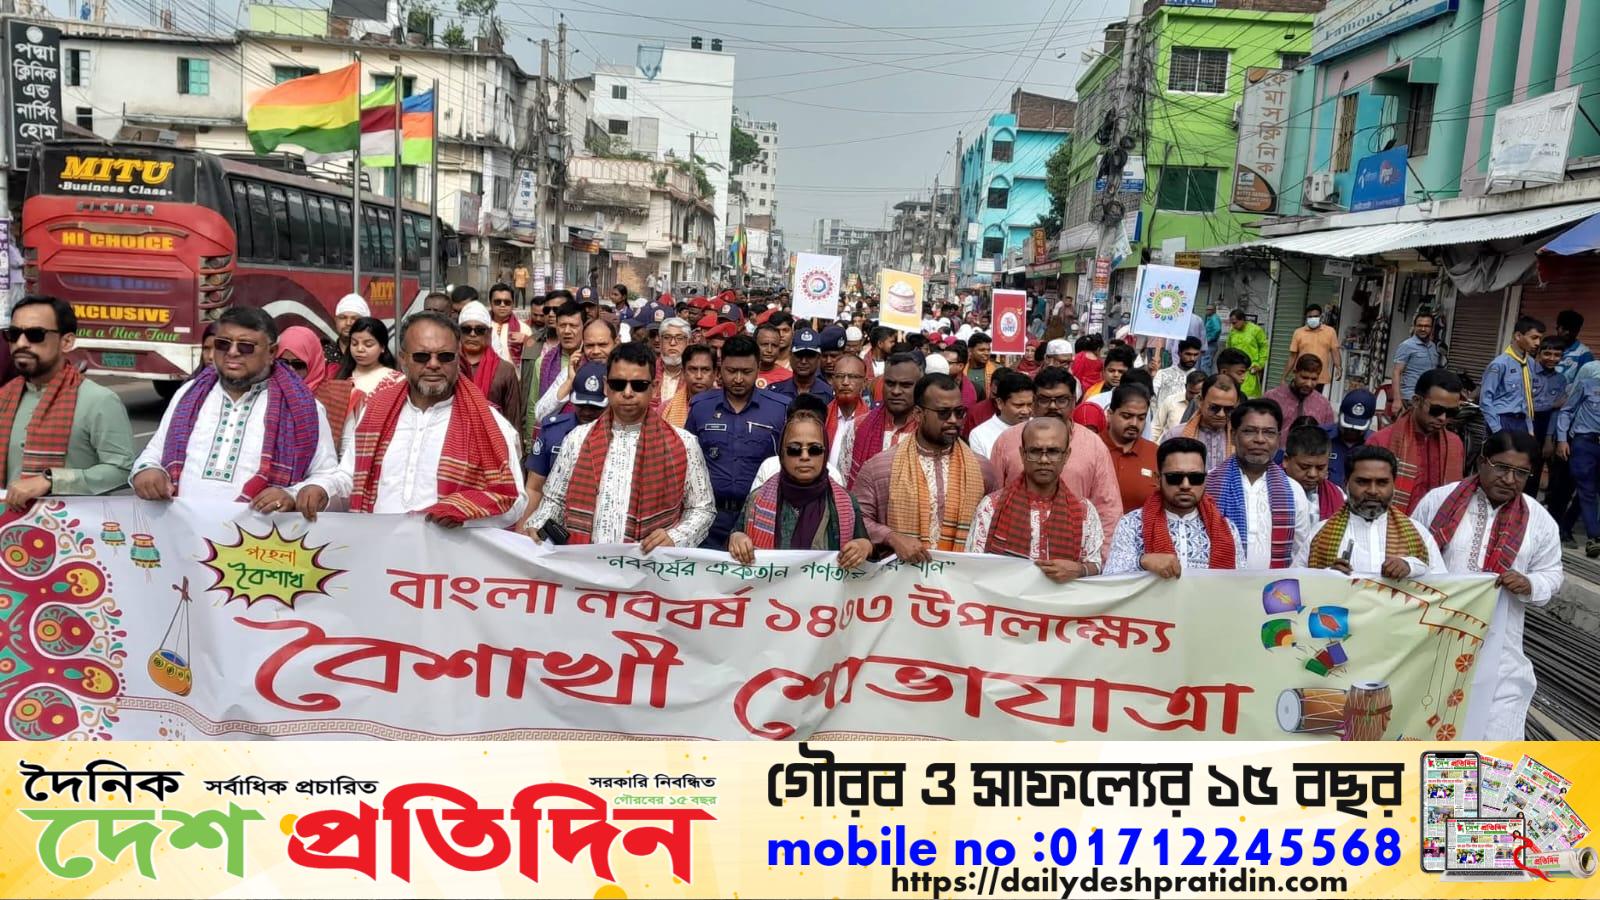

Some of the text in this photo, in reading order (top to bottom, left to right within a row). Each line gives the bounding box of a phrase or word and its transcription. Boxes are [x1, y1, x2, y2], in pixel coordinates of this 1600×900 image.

[15, 42, 56, 63] পদ্মা
[13, 58, 58, 82] ক্লিনিক
[22, 83, 51, 99] এন্ড
[16, 100, 58, 123] নার্সিং
[19, 122, 57, 141] হোম
[60, 155, 175, 185] MITU
[61, 181, 167, 196] Business Class
[62, 231, 175, 249] HI CHOICE
[74, 304, 170, 322] XCLUSIVE
[108, 326, 141, 339] Nice
[144, 327, 181, 342] Tour
[245, 546, 297, 567] পহেলা
[227, 562, 305, 589] বৈশাখ
[386, 568, 562, 615] বাংলা
[574, 586, 753, 631] নববর্ষ
[908, 584, 1176, 653] উপলক্ষ্যে
[233, 616, 1255, 741] বৈশাখী শোভাযাত্রা
